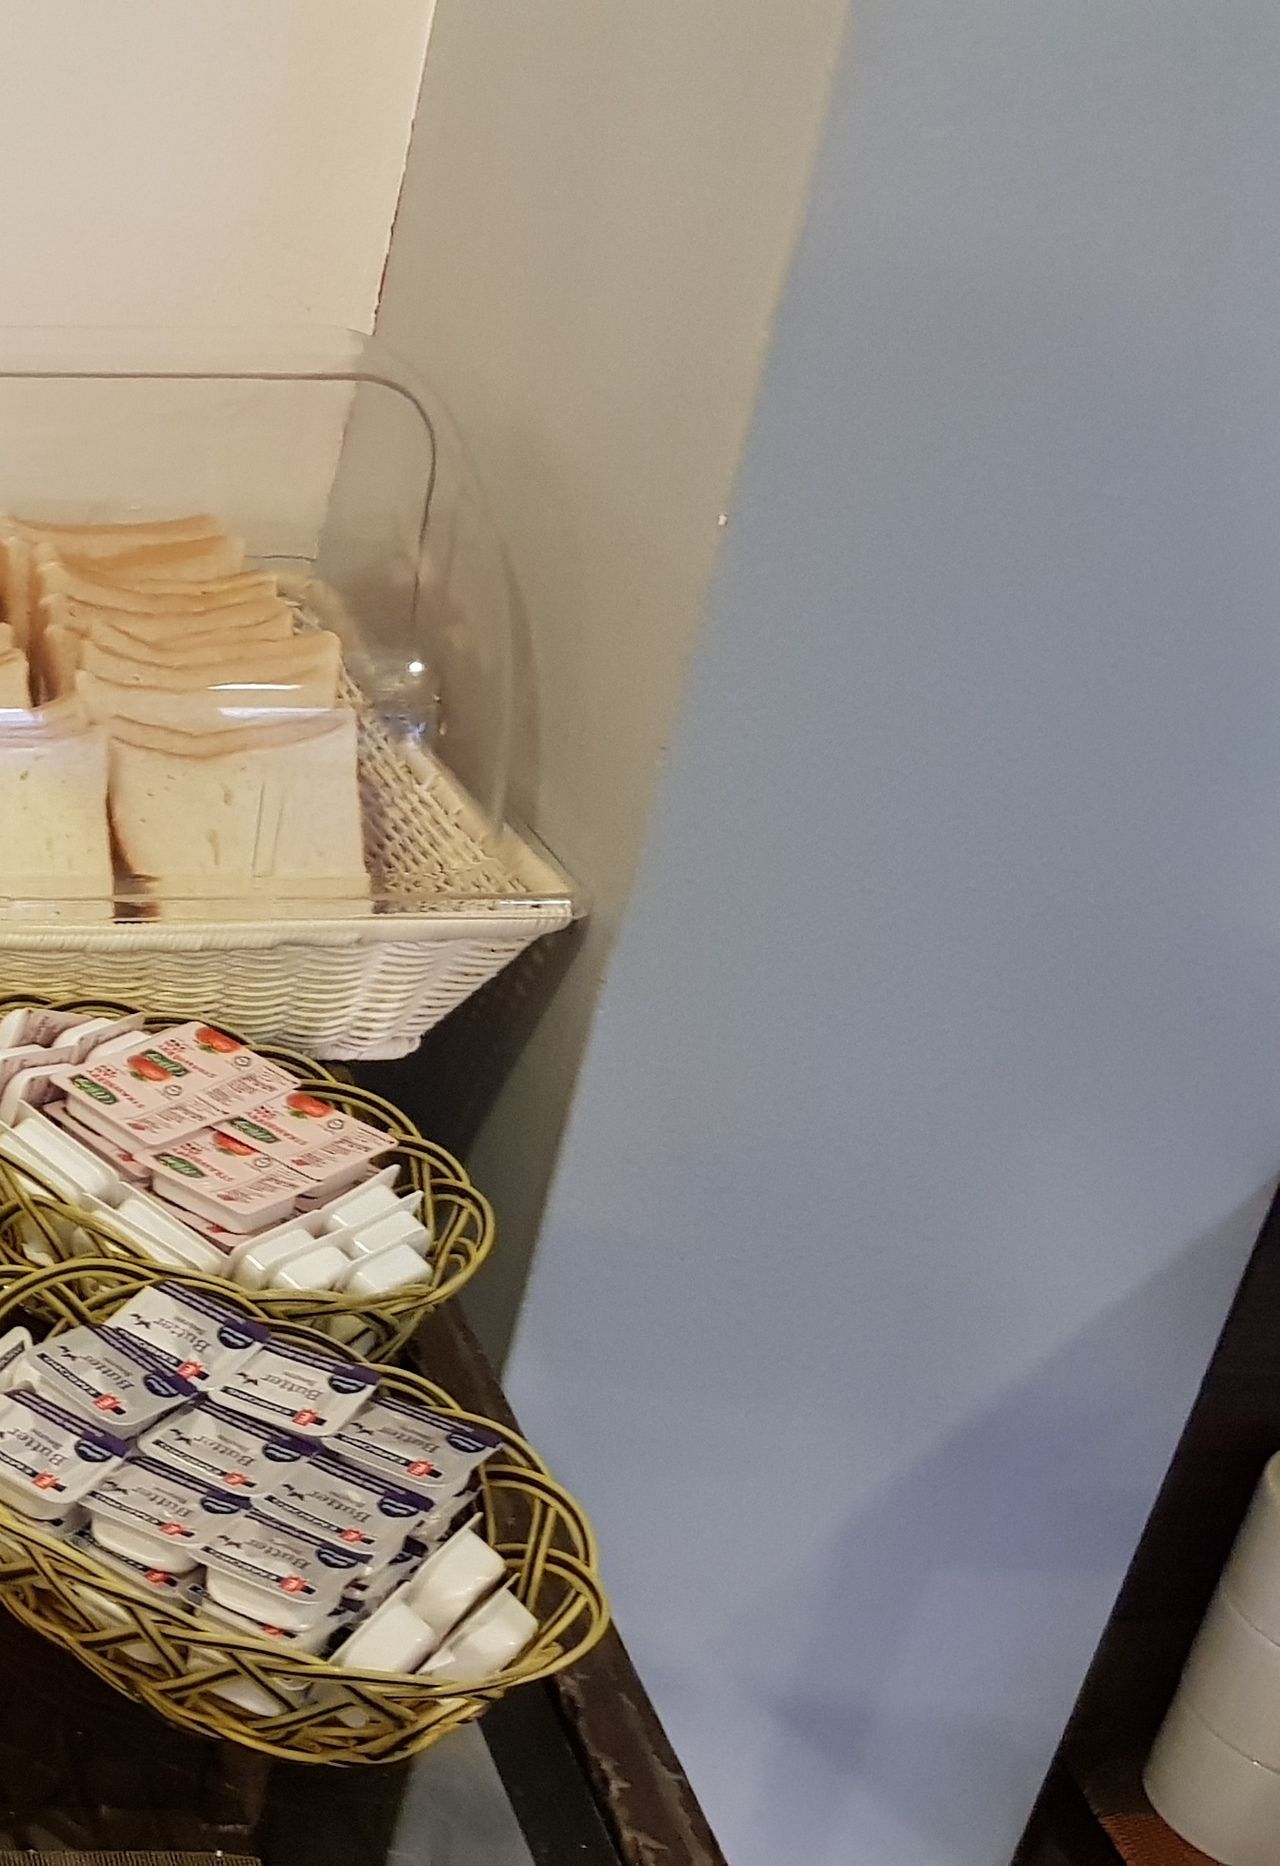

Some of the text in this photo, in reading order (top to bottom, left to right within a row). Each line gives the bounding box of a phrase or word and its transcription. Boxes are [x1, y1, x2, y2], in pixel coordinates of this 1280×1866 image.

[77, 1351, 136, 1394] Butter
[259, 1370, 323, 1404] Butter
[5, 1425, 68, 1469] Butter
[304, 1487, 372, 1525] Butter
